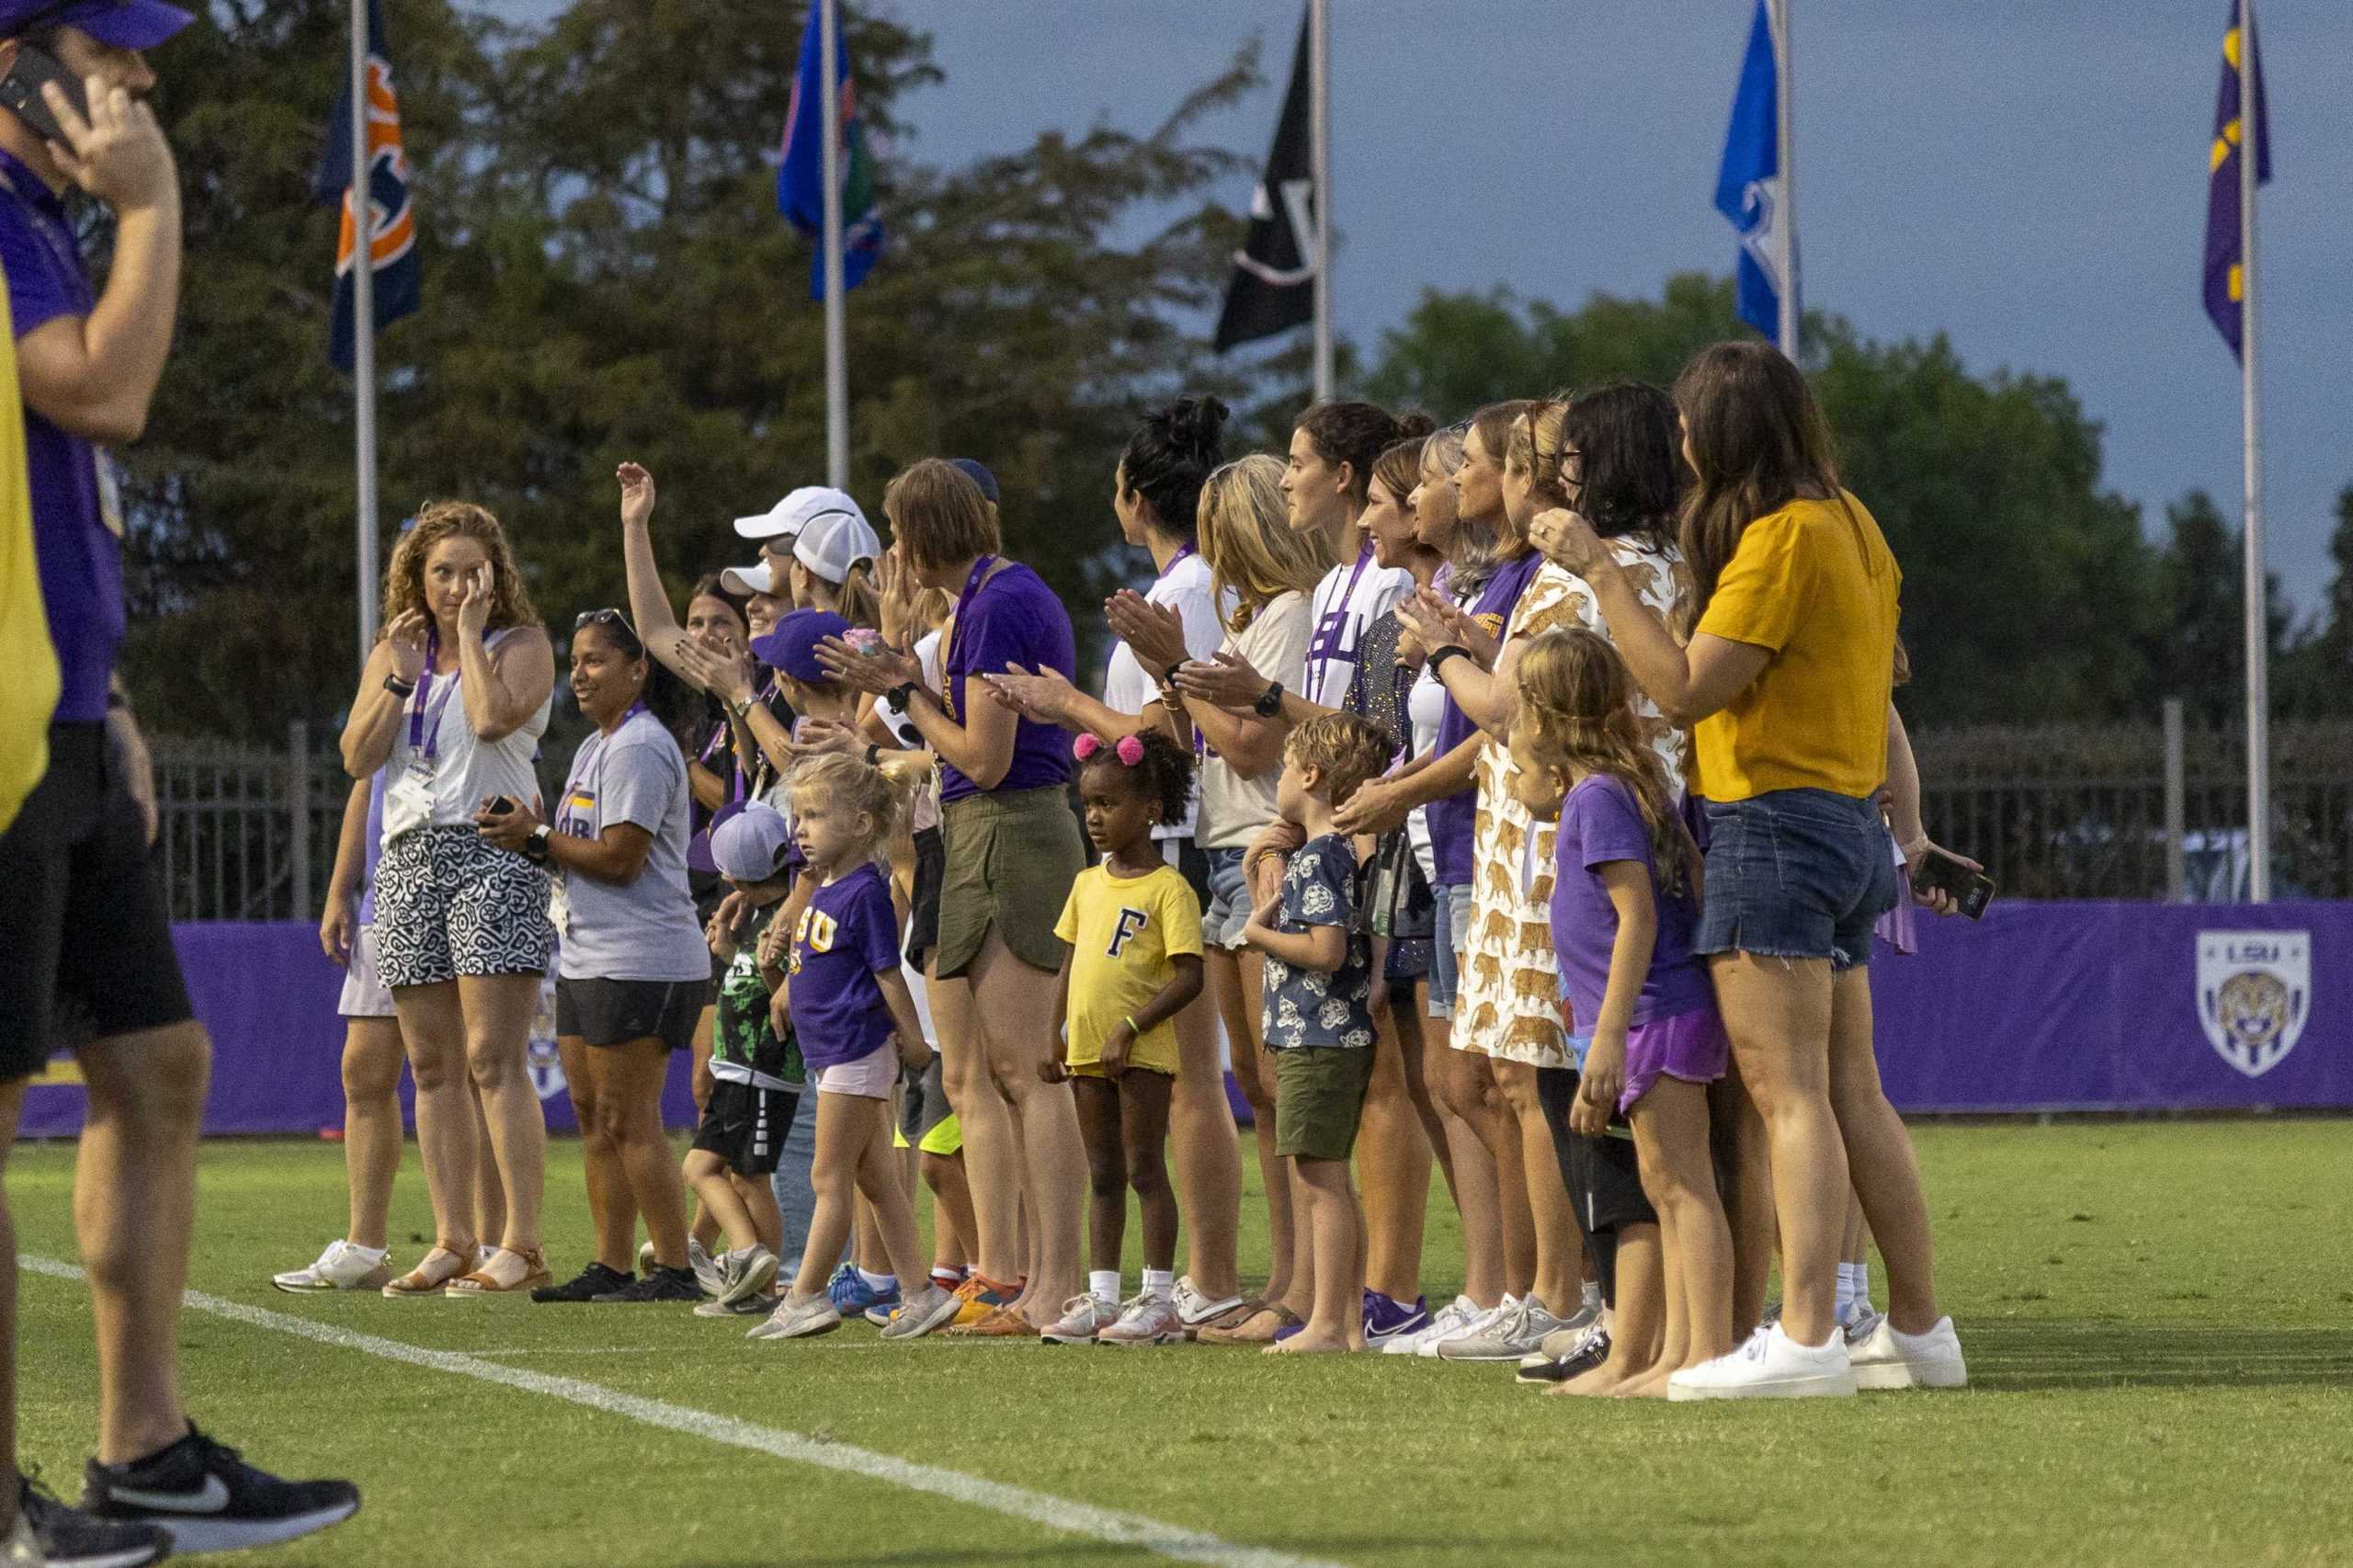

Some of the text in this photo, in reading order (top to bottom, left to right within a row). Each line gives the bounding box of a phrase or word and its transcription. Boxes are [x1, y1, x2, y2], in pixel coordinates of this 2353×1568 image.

[794, 905, 838, 952] SU
[1106, 907, 1148, 958] F
[2227, 945, 2280, 963] LSU
